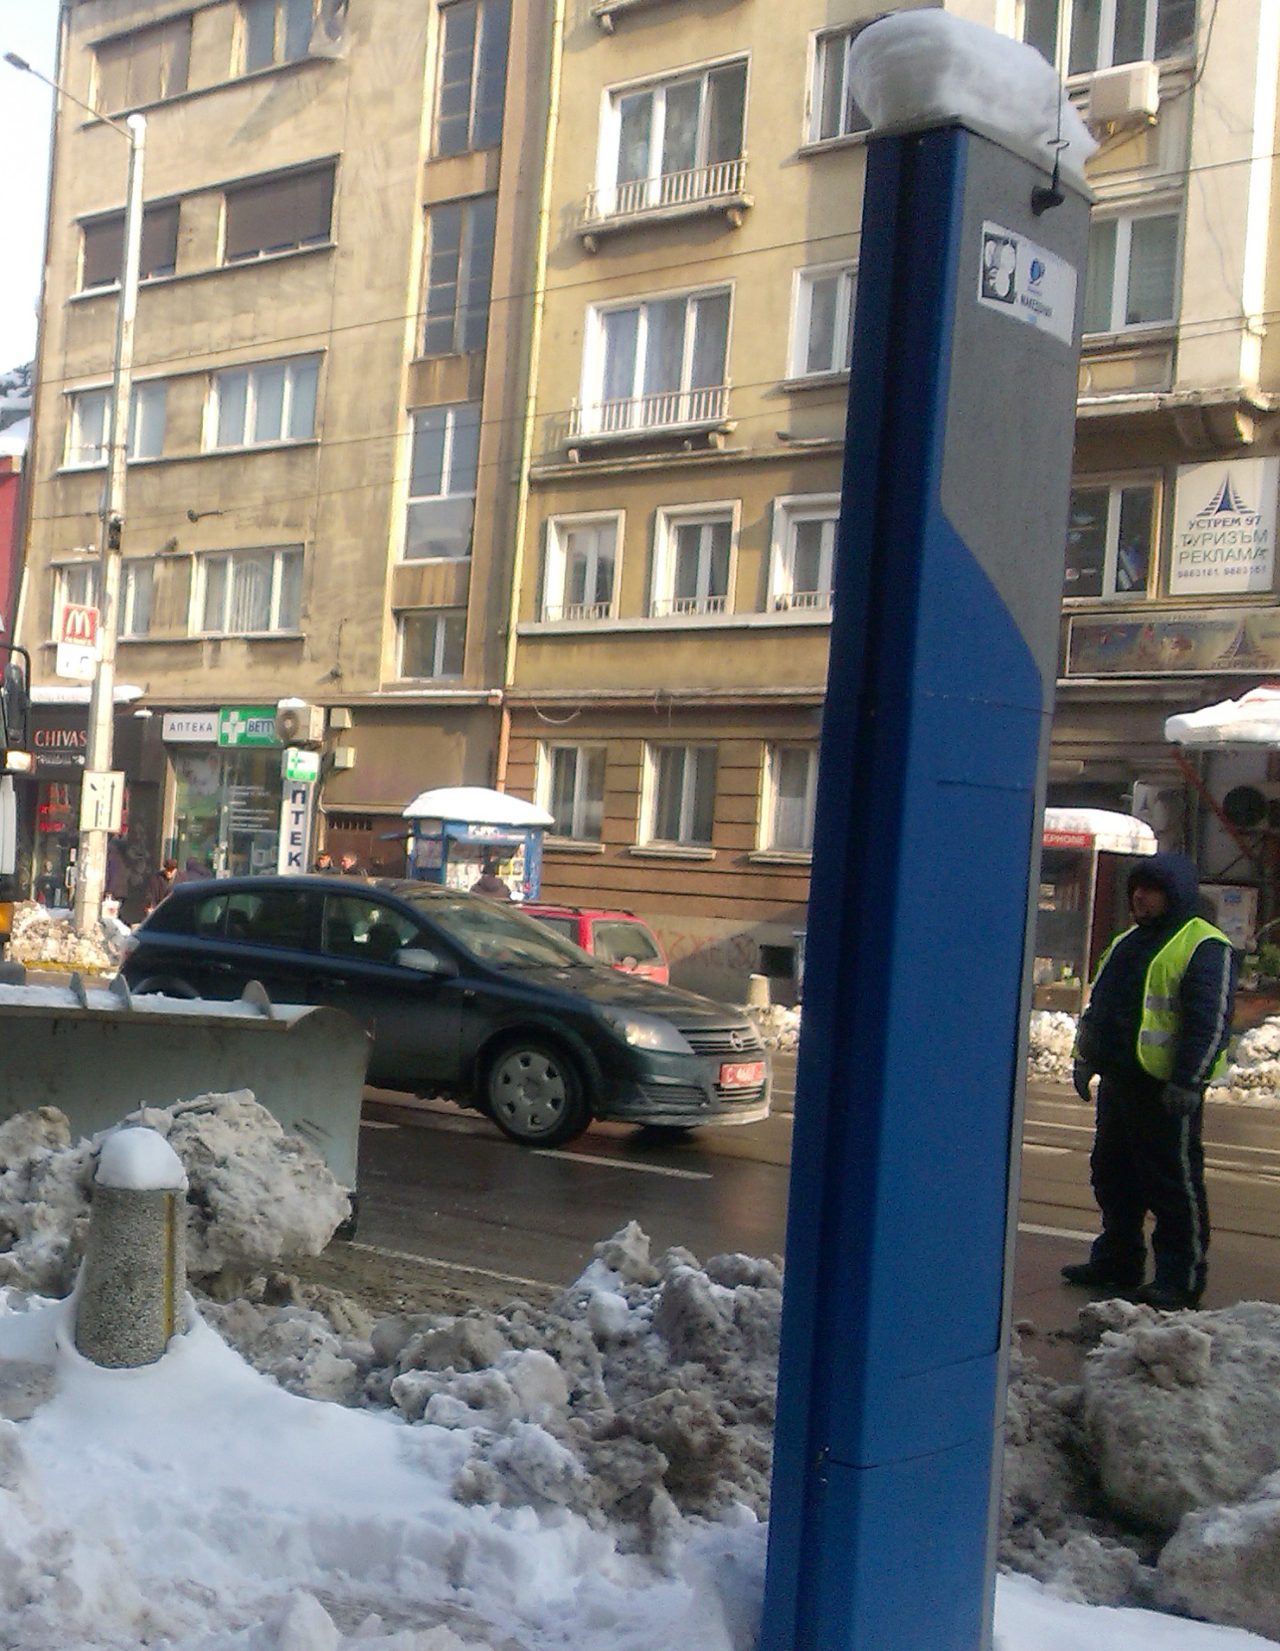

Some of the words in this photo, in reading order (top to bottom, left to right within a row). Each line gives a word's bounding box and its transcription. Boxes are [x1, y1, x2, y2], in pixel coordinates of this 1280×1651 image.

[1181, 528, 1268, 547] ТУРИЗЪМ
[1179, 547, 1268, 564] РЕКЛАМА
[169, 722, 213, 732] АПТЕКА
[34, 730, 87, 747] CHIVAS
[287, 789, 306, 867] ПТЕК
